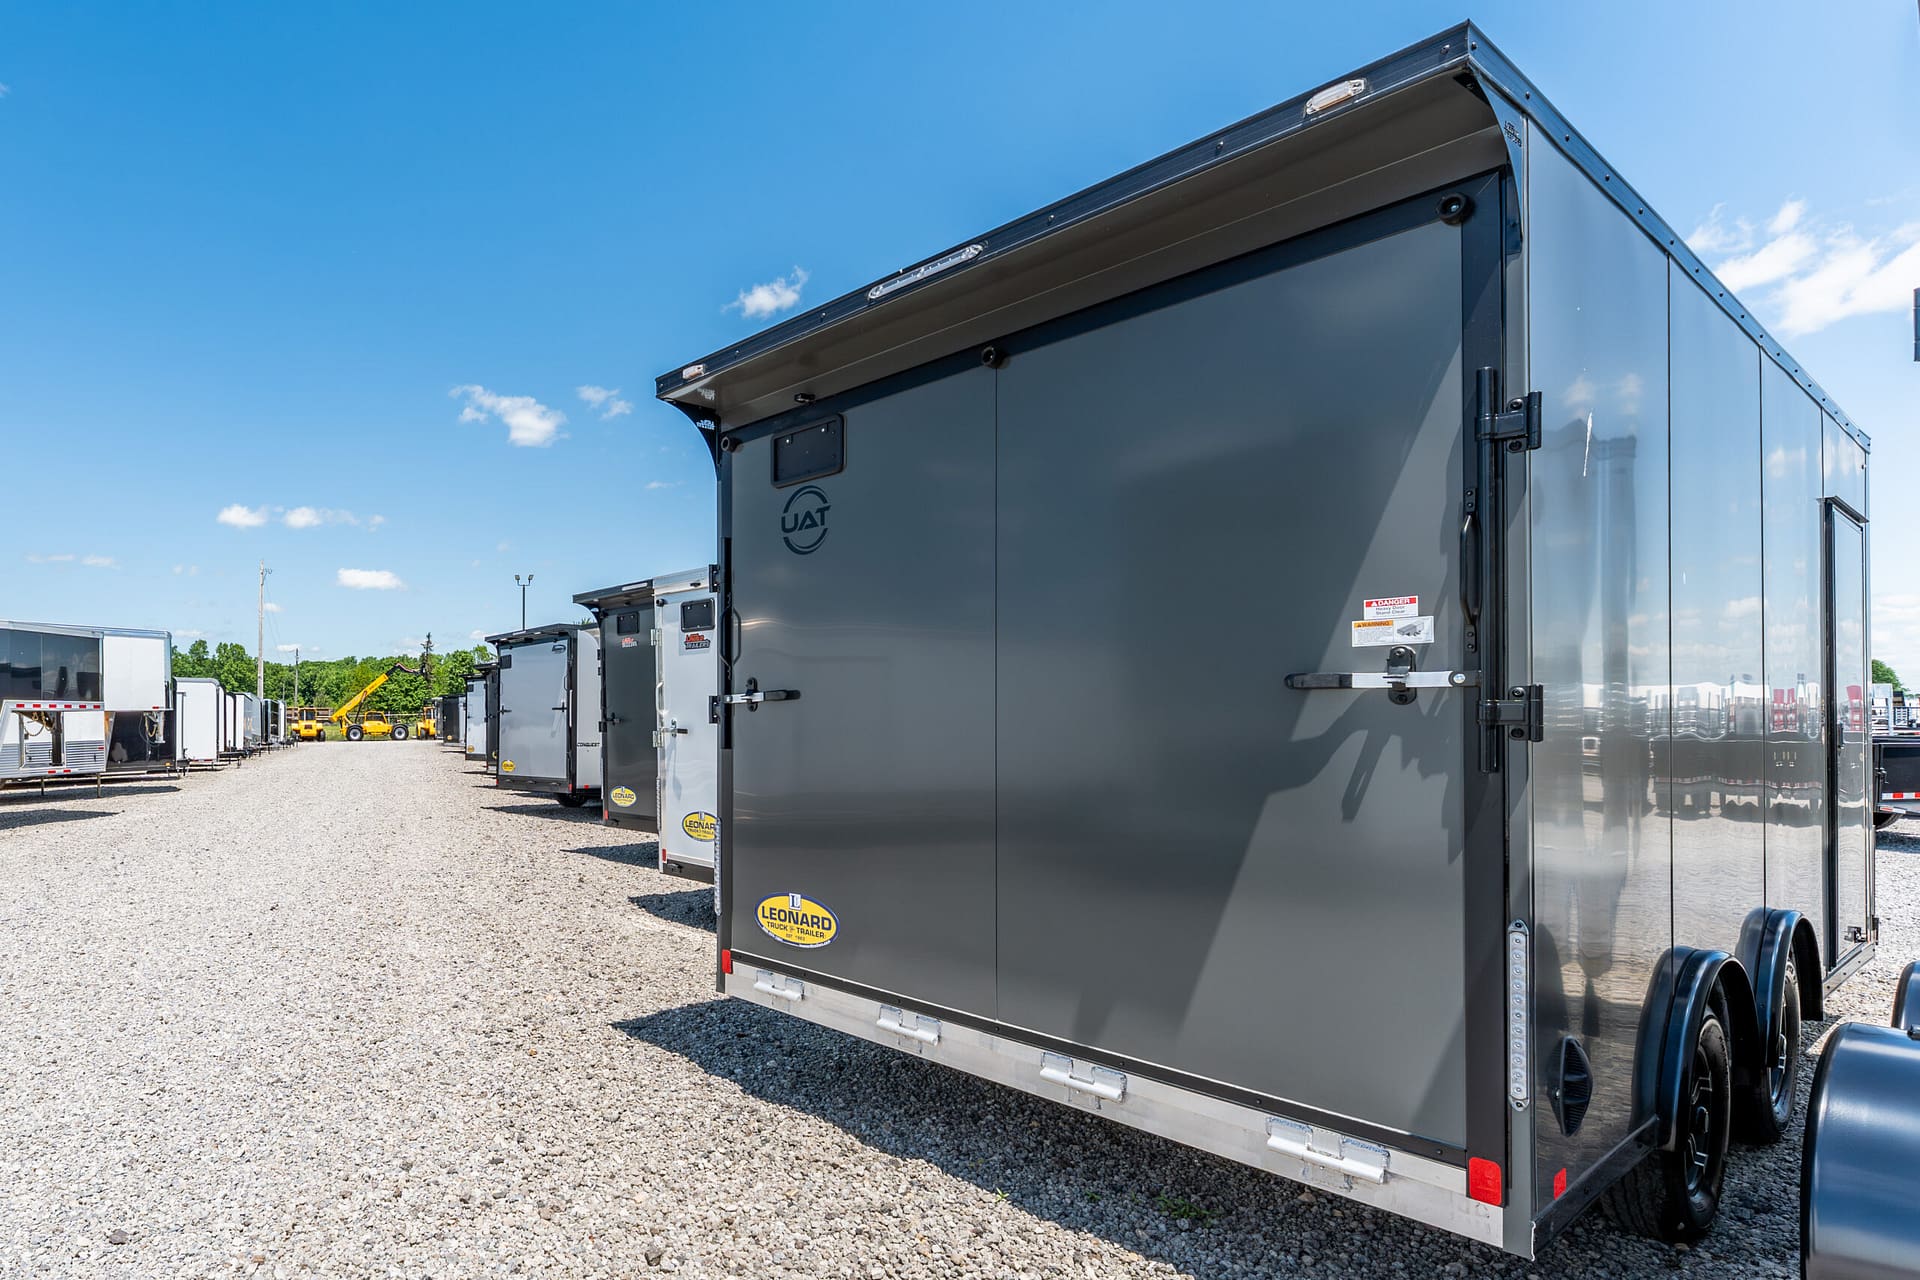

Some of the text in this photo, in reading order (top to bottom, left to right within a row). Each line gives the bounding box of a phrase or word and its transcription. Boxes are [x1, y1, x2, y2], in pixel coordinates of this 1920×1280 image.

[781, 505, 831, 533] UAT
[1378, 598, 1410, 606] DANGER
[685, 820, 716, 829] LEONAR
[762, 906, 832, 931] LEONARD
[767, 921, 788, 931] TRUCK
[796, 927, 825, 938] TRAILER
